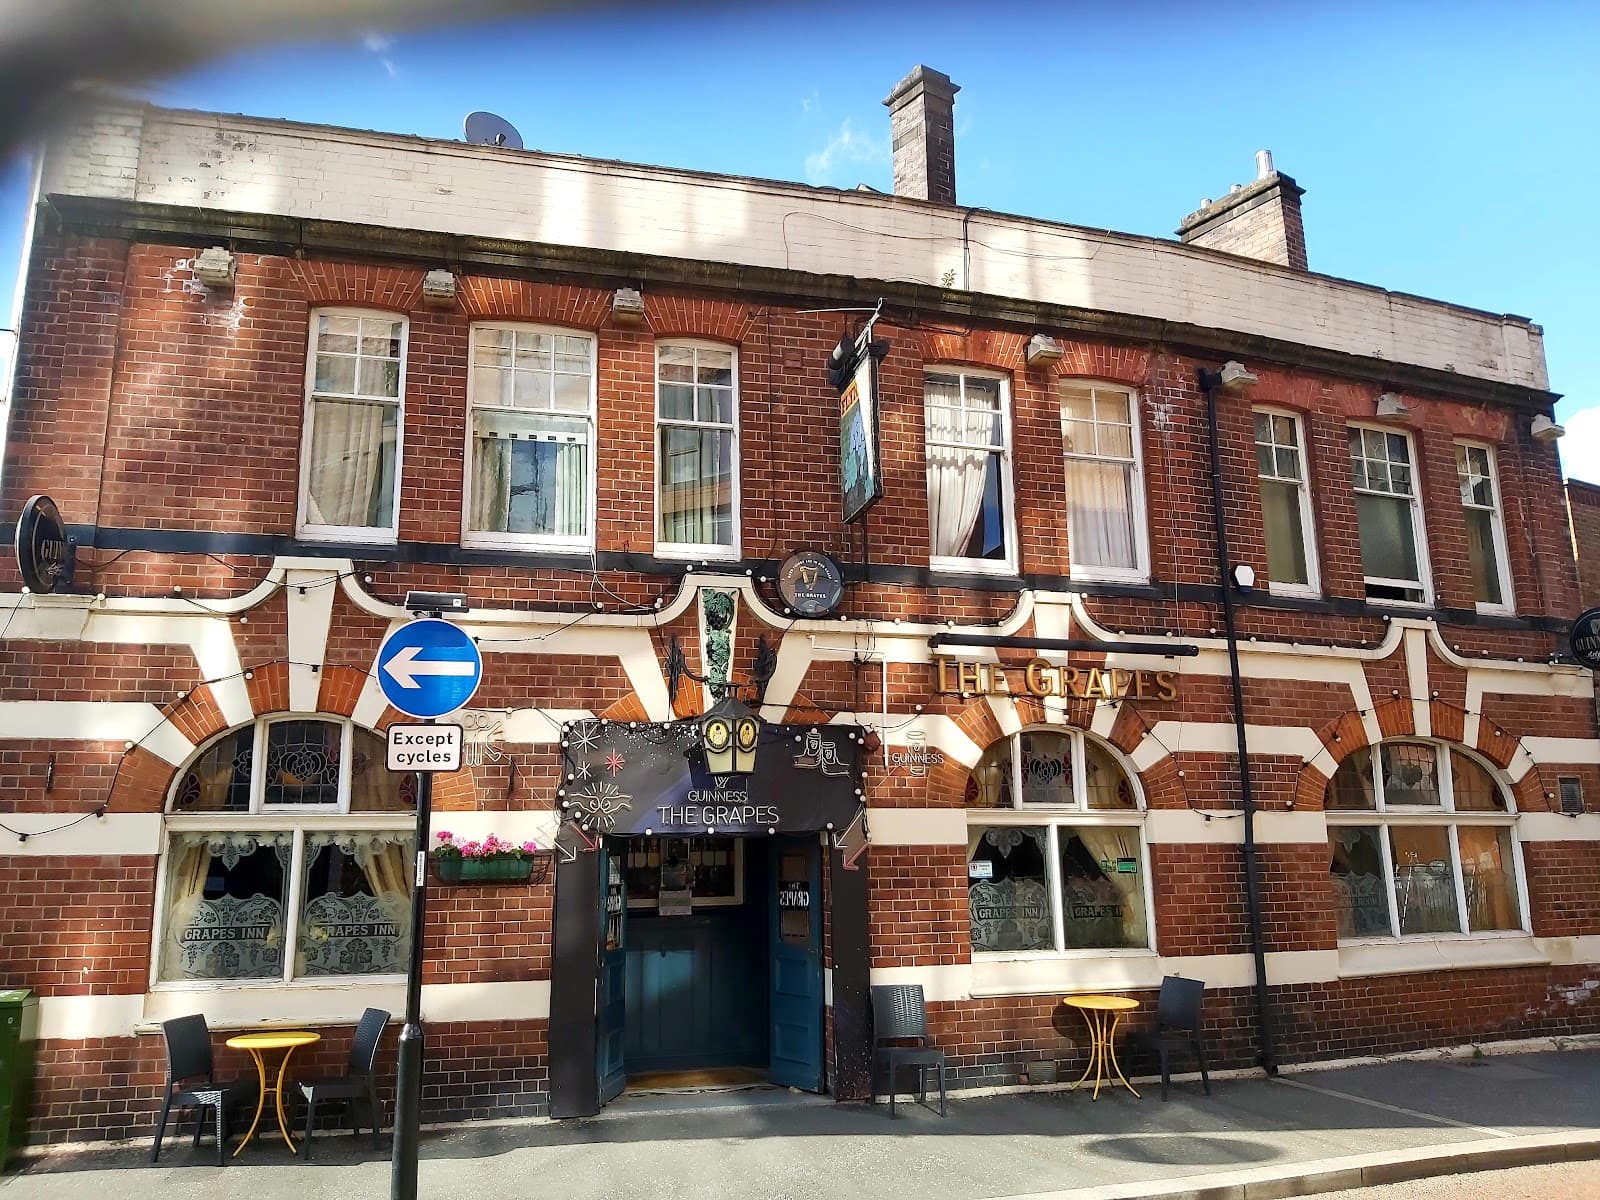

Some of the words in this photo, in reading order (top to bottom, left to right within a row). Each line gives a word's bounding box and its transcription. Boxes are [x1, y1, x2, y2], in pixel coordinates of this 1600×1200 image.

[932, 655, 1005, 695] THE
[1026, 658, 1178, 701] GRAPES
[393, 732, 453, 747] Except
[396, 750, 451, 765] cycles
[892, 752, 944, 764] GUINNESS
[687, 790, 748, 802] GUINNESS
[657, 805, 698, 825] THE
[702, 805, 779, 825] GRAPES
[978, 906, 1017, 919] GRAPES
[1022, 906, 1039, 918] INN
[184, 928, 236, 940] GRAPES
[241, 927, 265, 938] INN
[321, 924, 369, 937] RAPES
[373, 924, 396, 935] INN
